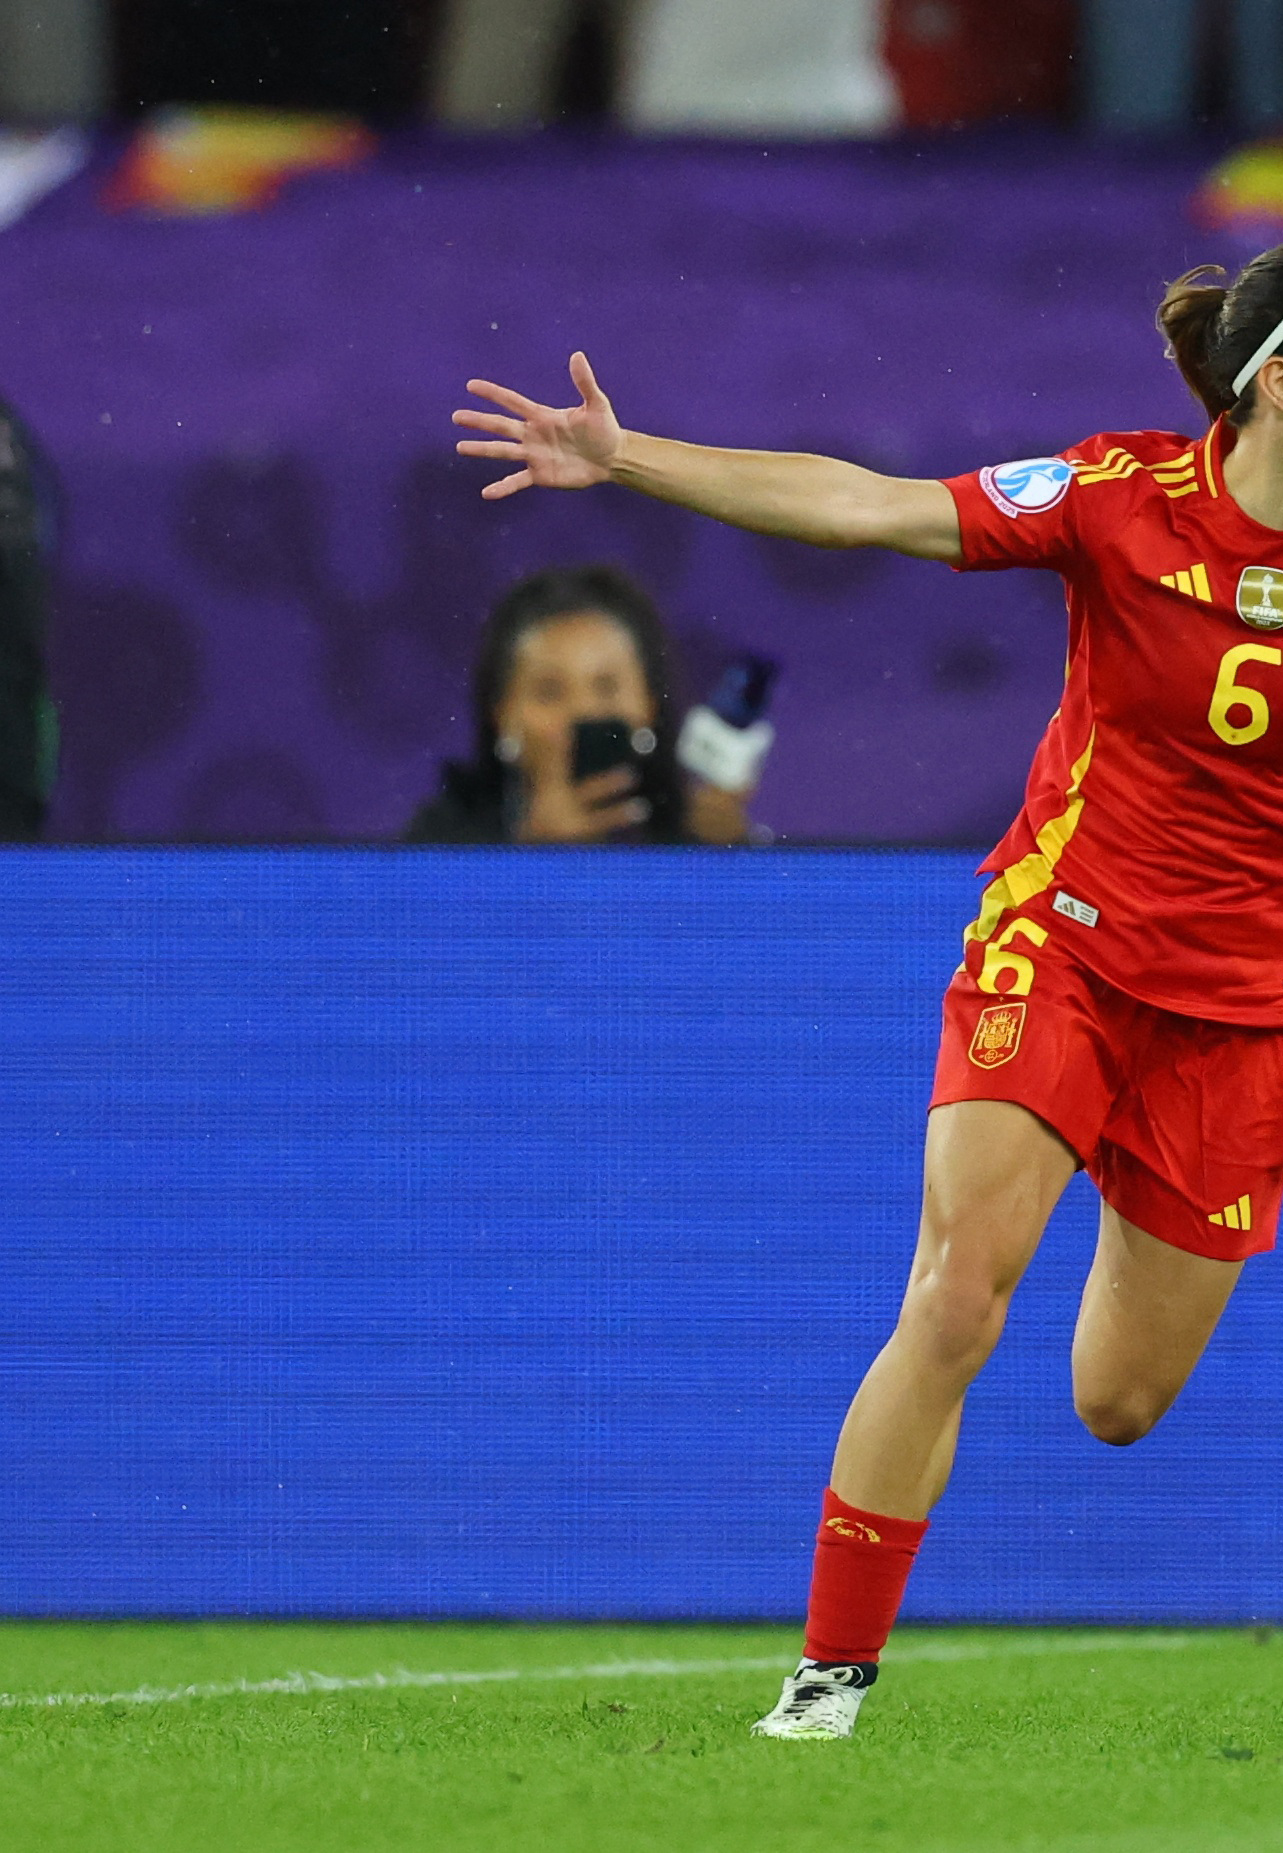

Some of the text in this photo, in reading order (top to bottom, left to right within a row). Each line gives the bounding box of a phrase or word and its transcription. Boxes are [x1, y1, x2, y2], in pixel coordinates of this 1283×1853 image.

[1252, 605, 1278, 618] FIFA
[1208, 643, 1282, 745] 6
[977, 917, 1048, 996] 6
